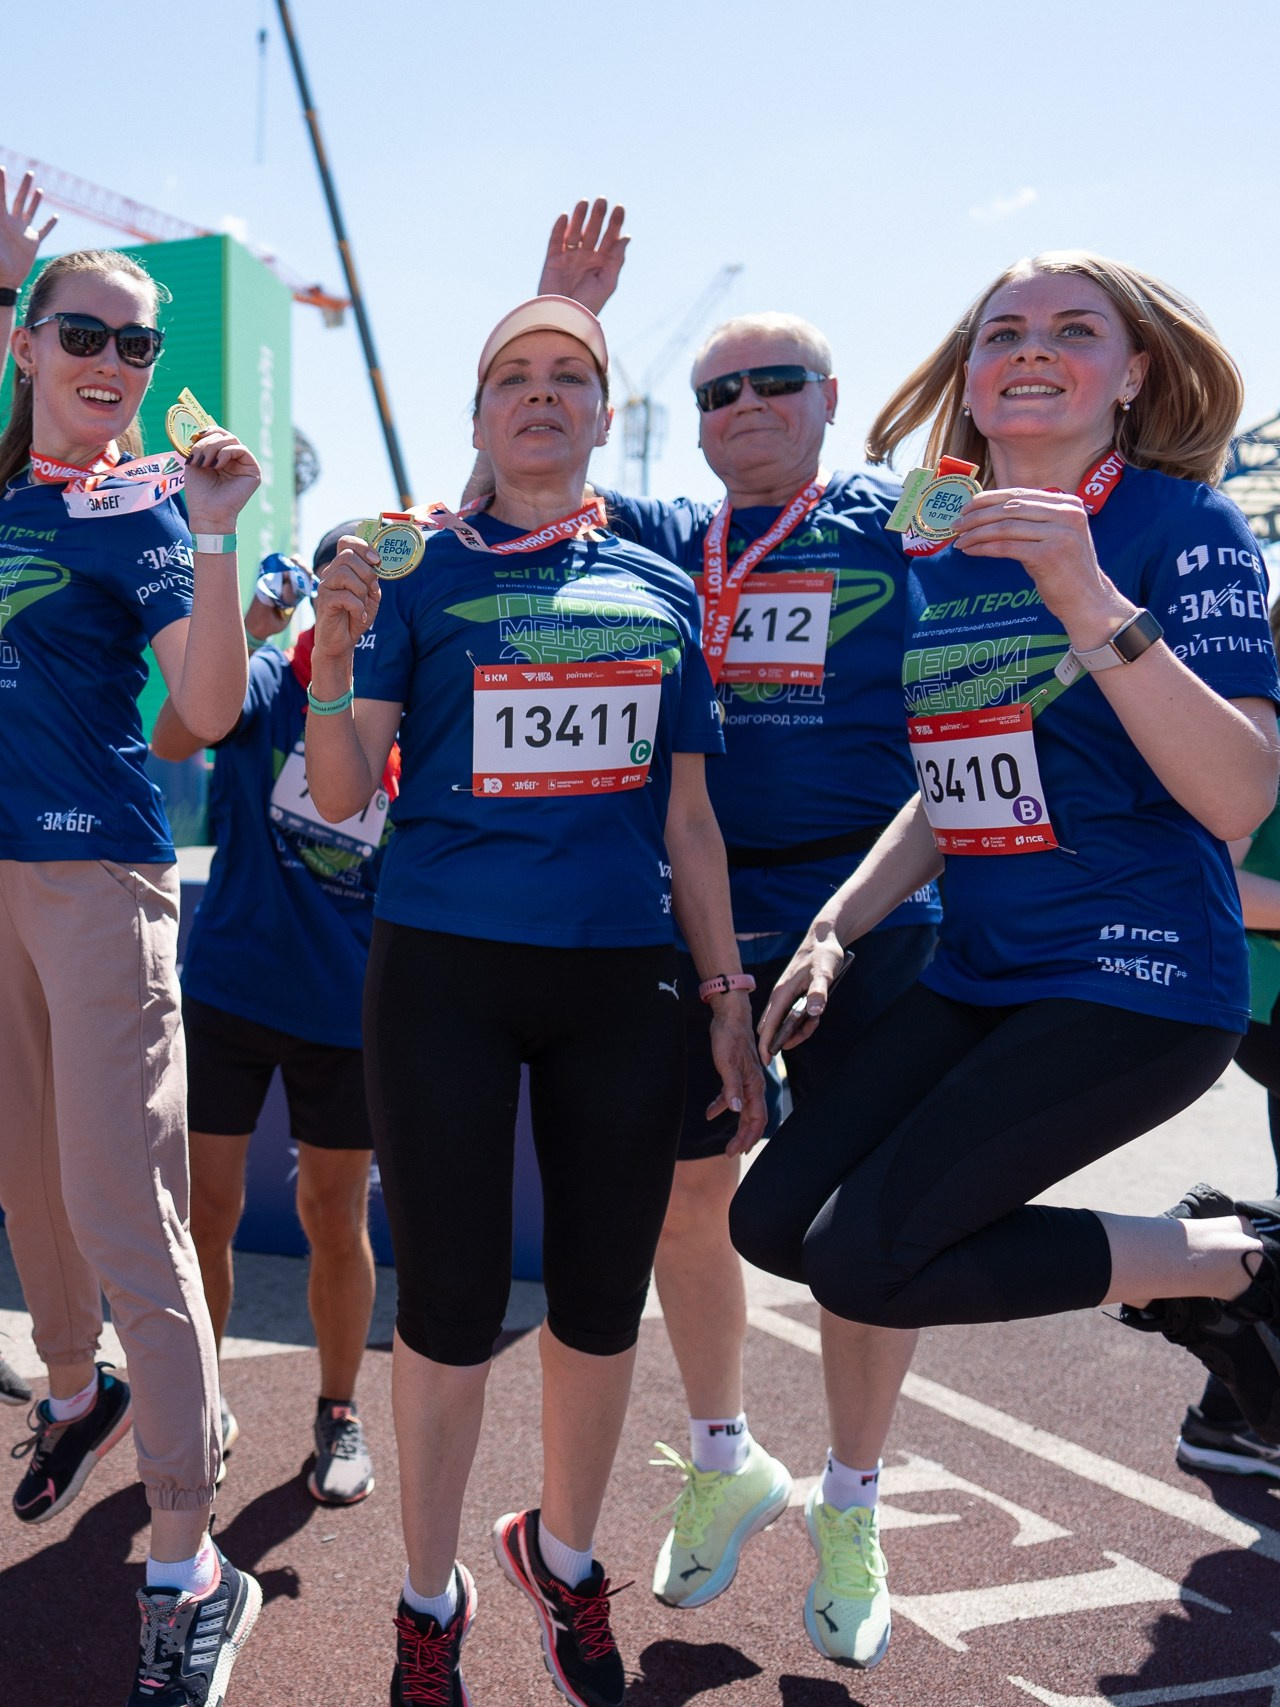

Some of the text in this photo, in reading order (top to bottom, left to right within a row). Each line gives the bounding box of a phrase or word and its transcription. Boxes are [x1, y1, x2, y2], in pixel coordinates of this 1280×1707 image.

[935, 491, 962, 504] БЕГИ,
[560, 508, 599, 533] ЭТОТ
[937, 512, 954, 521] ЛЕТ
[378, 545, 411, 556] ГЕРОЙ!
[384, 538, 408, 548] БЕГИ,
[1217, 547, 1262, 574] ПСБ
[496, 593, 662, 636] ГЕРОИ
[919, 597, 969, 622] БЕГИ,
[500, 619, 663, 655] МЕНЯЮТ
[731, 607, 812, 642] 412
[1173, 633, 1274, 660] ейтинг
[903, 635, 1032, 685] ГЕРОИ
[484, 674, 490, 682] 5
[903, 676, 1028, 711] МЕНЯЮТ
[496, 702, 638, 749] 13411
[793, 715, 824, 724] 2024
[917, 753, 1021, 804] 13410
[1025, 835, 1044, 843] ПСБ
[1131, 927, 1180, 943] ПСБ
